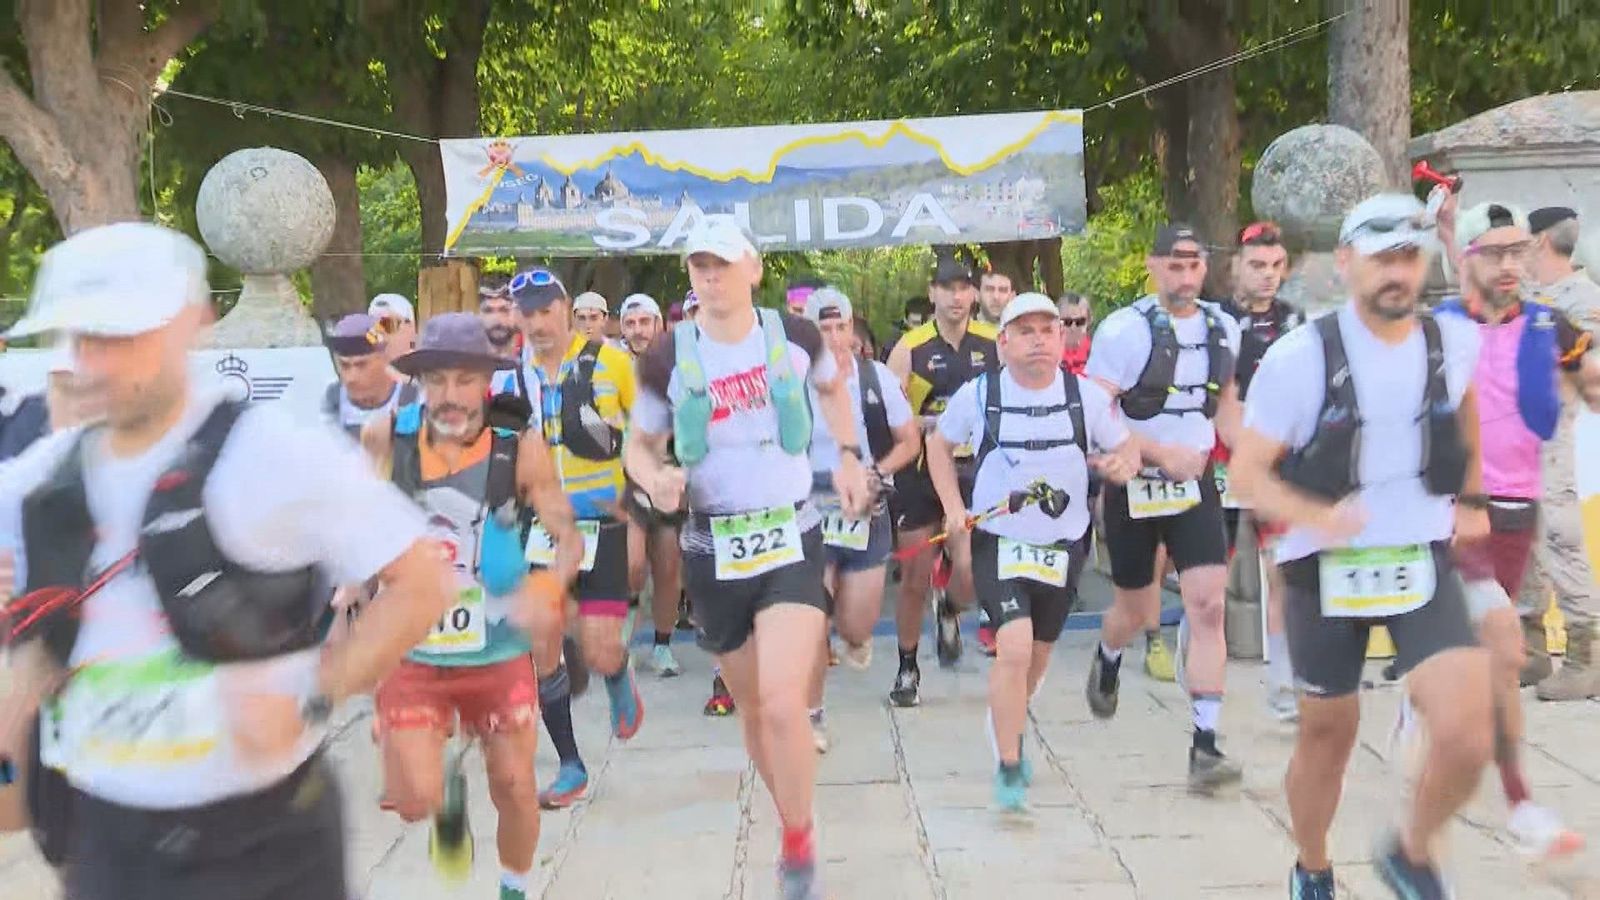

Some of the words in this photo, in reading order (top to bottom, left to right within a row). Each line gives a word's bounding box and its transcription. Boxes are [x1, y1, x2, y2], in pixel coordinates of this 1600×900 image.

[593, 192, 960, 248] SALIDA
[1141, 481, 1186, 500] 115
[730, 528, 787, 560] 322
[1013, 545, 1057, 568] 118
